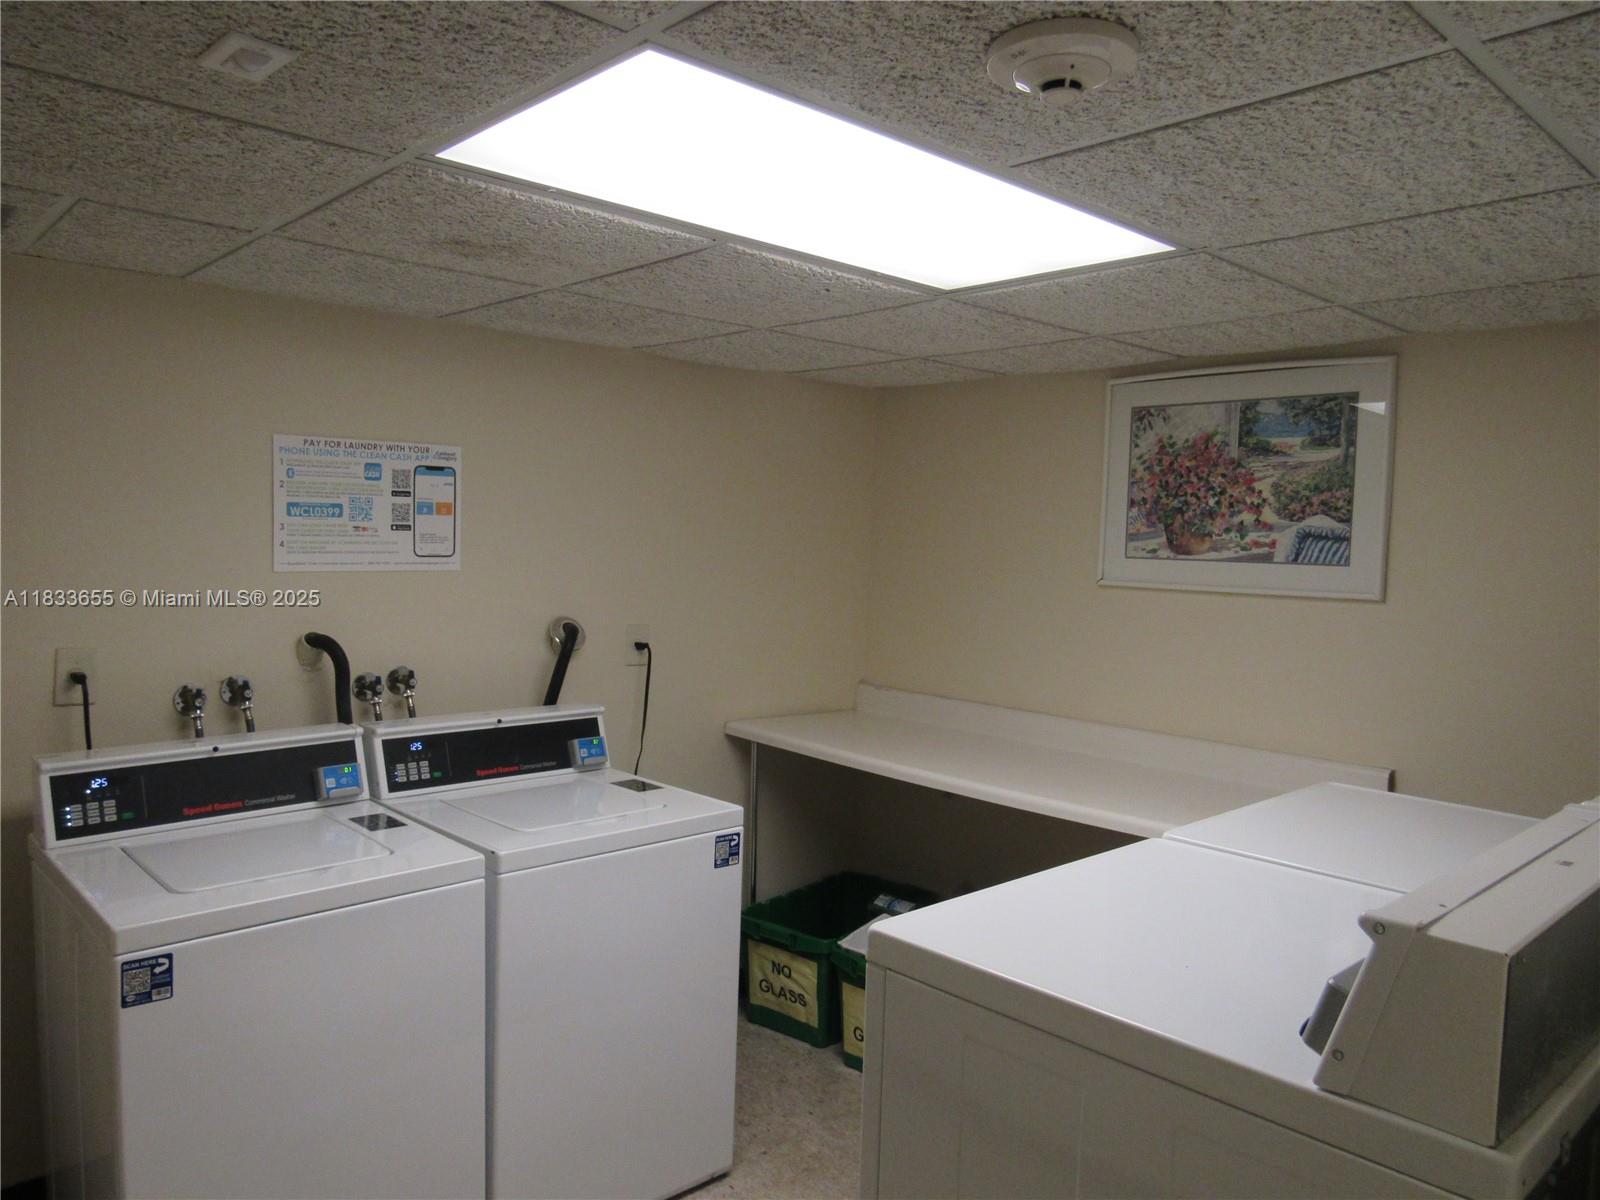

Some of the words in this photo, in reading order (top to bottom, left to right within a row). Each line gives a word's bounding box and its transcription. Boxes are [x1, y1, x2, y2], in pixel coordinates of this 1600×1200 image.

[303, 438, 322, 448] PAY
[324, 440, 342, 449] FOR
[344, 441, 384, 452] LAUNDRY
[385, 444, 406, 453] WITH
[408, 445, 431, 454] YOUR
[279, 446, 311, 457] PHONE
[312, 448, 340, 458] USING
[341, 450, 358, 460] THE
[359, 451, 387, 460] CLEAN
[389, 453, 412, 462] CASH
[414, 455, 431, 463] APP
[279, 480, 285, 488] 2
[279, 523, 285, 531] 3
[771, 960, 792, 979] NO
[759, 978, 808, 1008] GLASS
